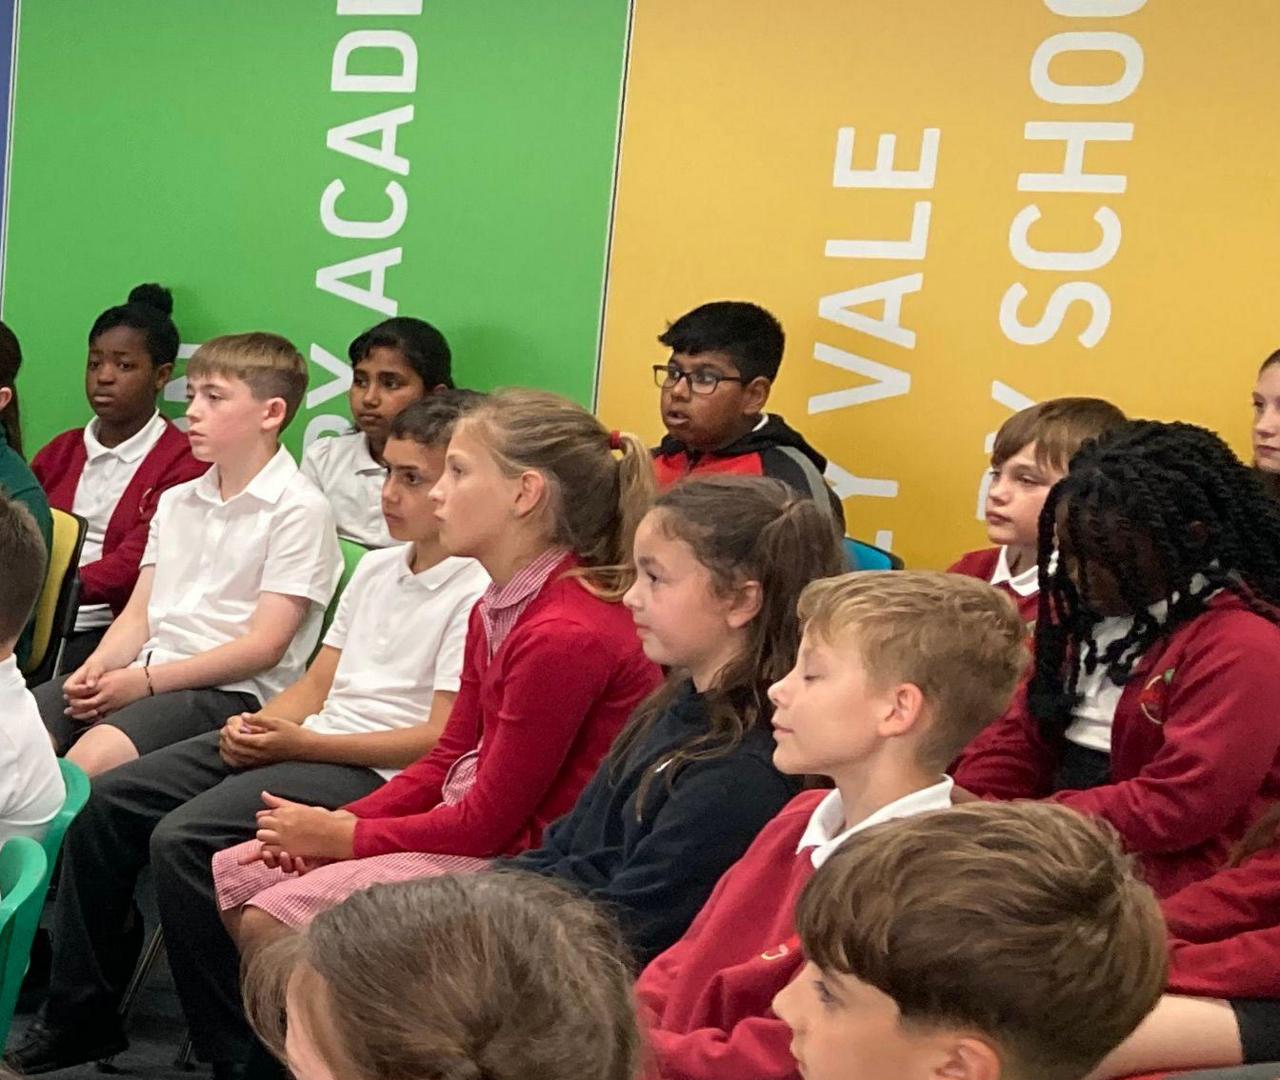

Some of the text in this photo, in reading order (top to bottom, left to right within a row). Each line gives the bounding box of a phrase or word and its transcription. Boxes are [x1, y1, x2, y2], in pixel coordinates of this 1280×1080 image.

[315, 0, 424, 316] ACAD
[807, 127, 941, 415] VALE
[998, 0, 1149, 349] SCHO
